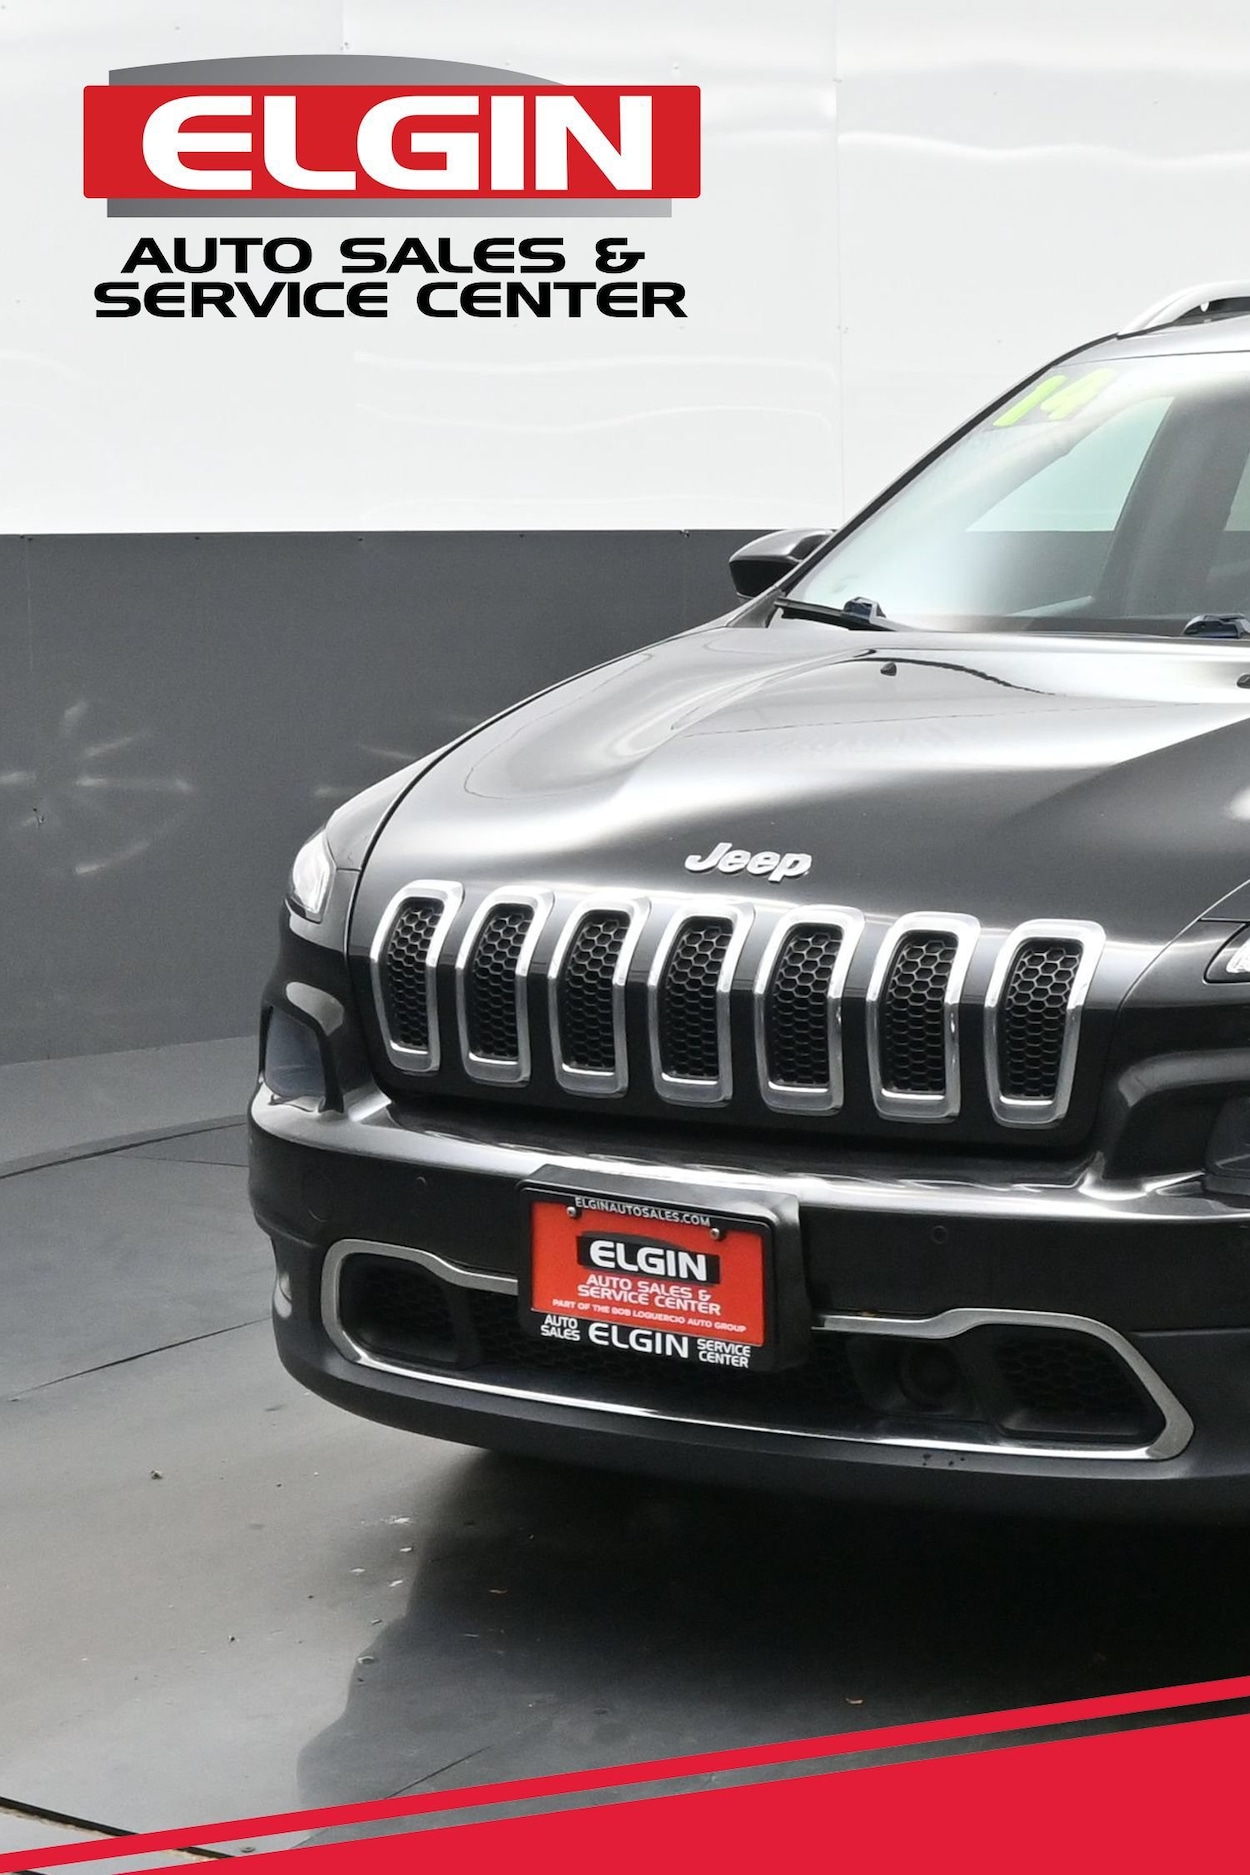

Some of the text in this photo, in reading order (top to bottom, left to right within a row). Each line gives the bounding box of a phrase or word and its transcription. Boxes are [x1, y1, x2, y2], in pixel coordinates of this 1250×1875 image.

[684, 842, 813, 883] Jeep
[574, 1197, 711, 1227] ELGINAUTOSALES.COM
[589, 1240, 707, 1281] ELGIN
[577, 1284, 721, 1316] SERVICE CENTER
[586, 1274, 712, 1302] AUTO SALES &
[544, 1313, 578, 1329] AUTO
[552, 1299, 576, 1309] PART
[578, 1303, 591, 1311] OF
[592, 1304, 610, 1314] THE
[611, 1307, 631, 1317] BOB
[687, 1318, 713, 1328] AUTO
[714, 1321, 747, 1333] GROUP
[541, 1326, 581, 1342] SALES
[588, 1322, 689, 1359] ELGIN
[697, 1338, 751, 1358] SERVICE
[699, 1351, 750, 1369] CENTER
